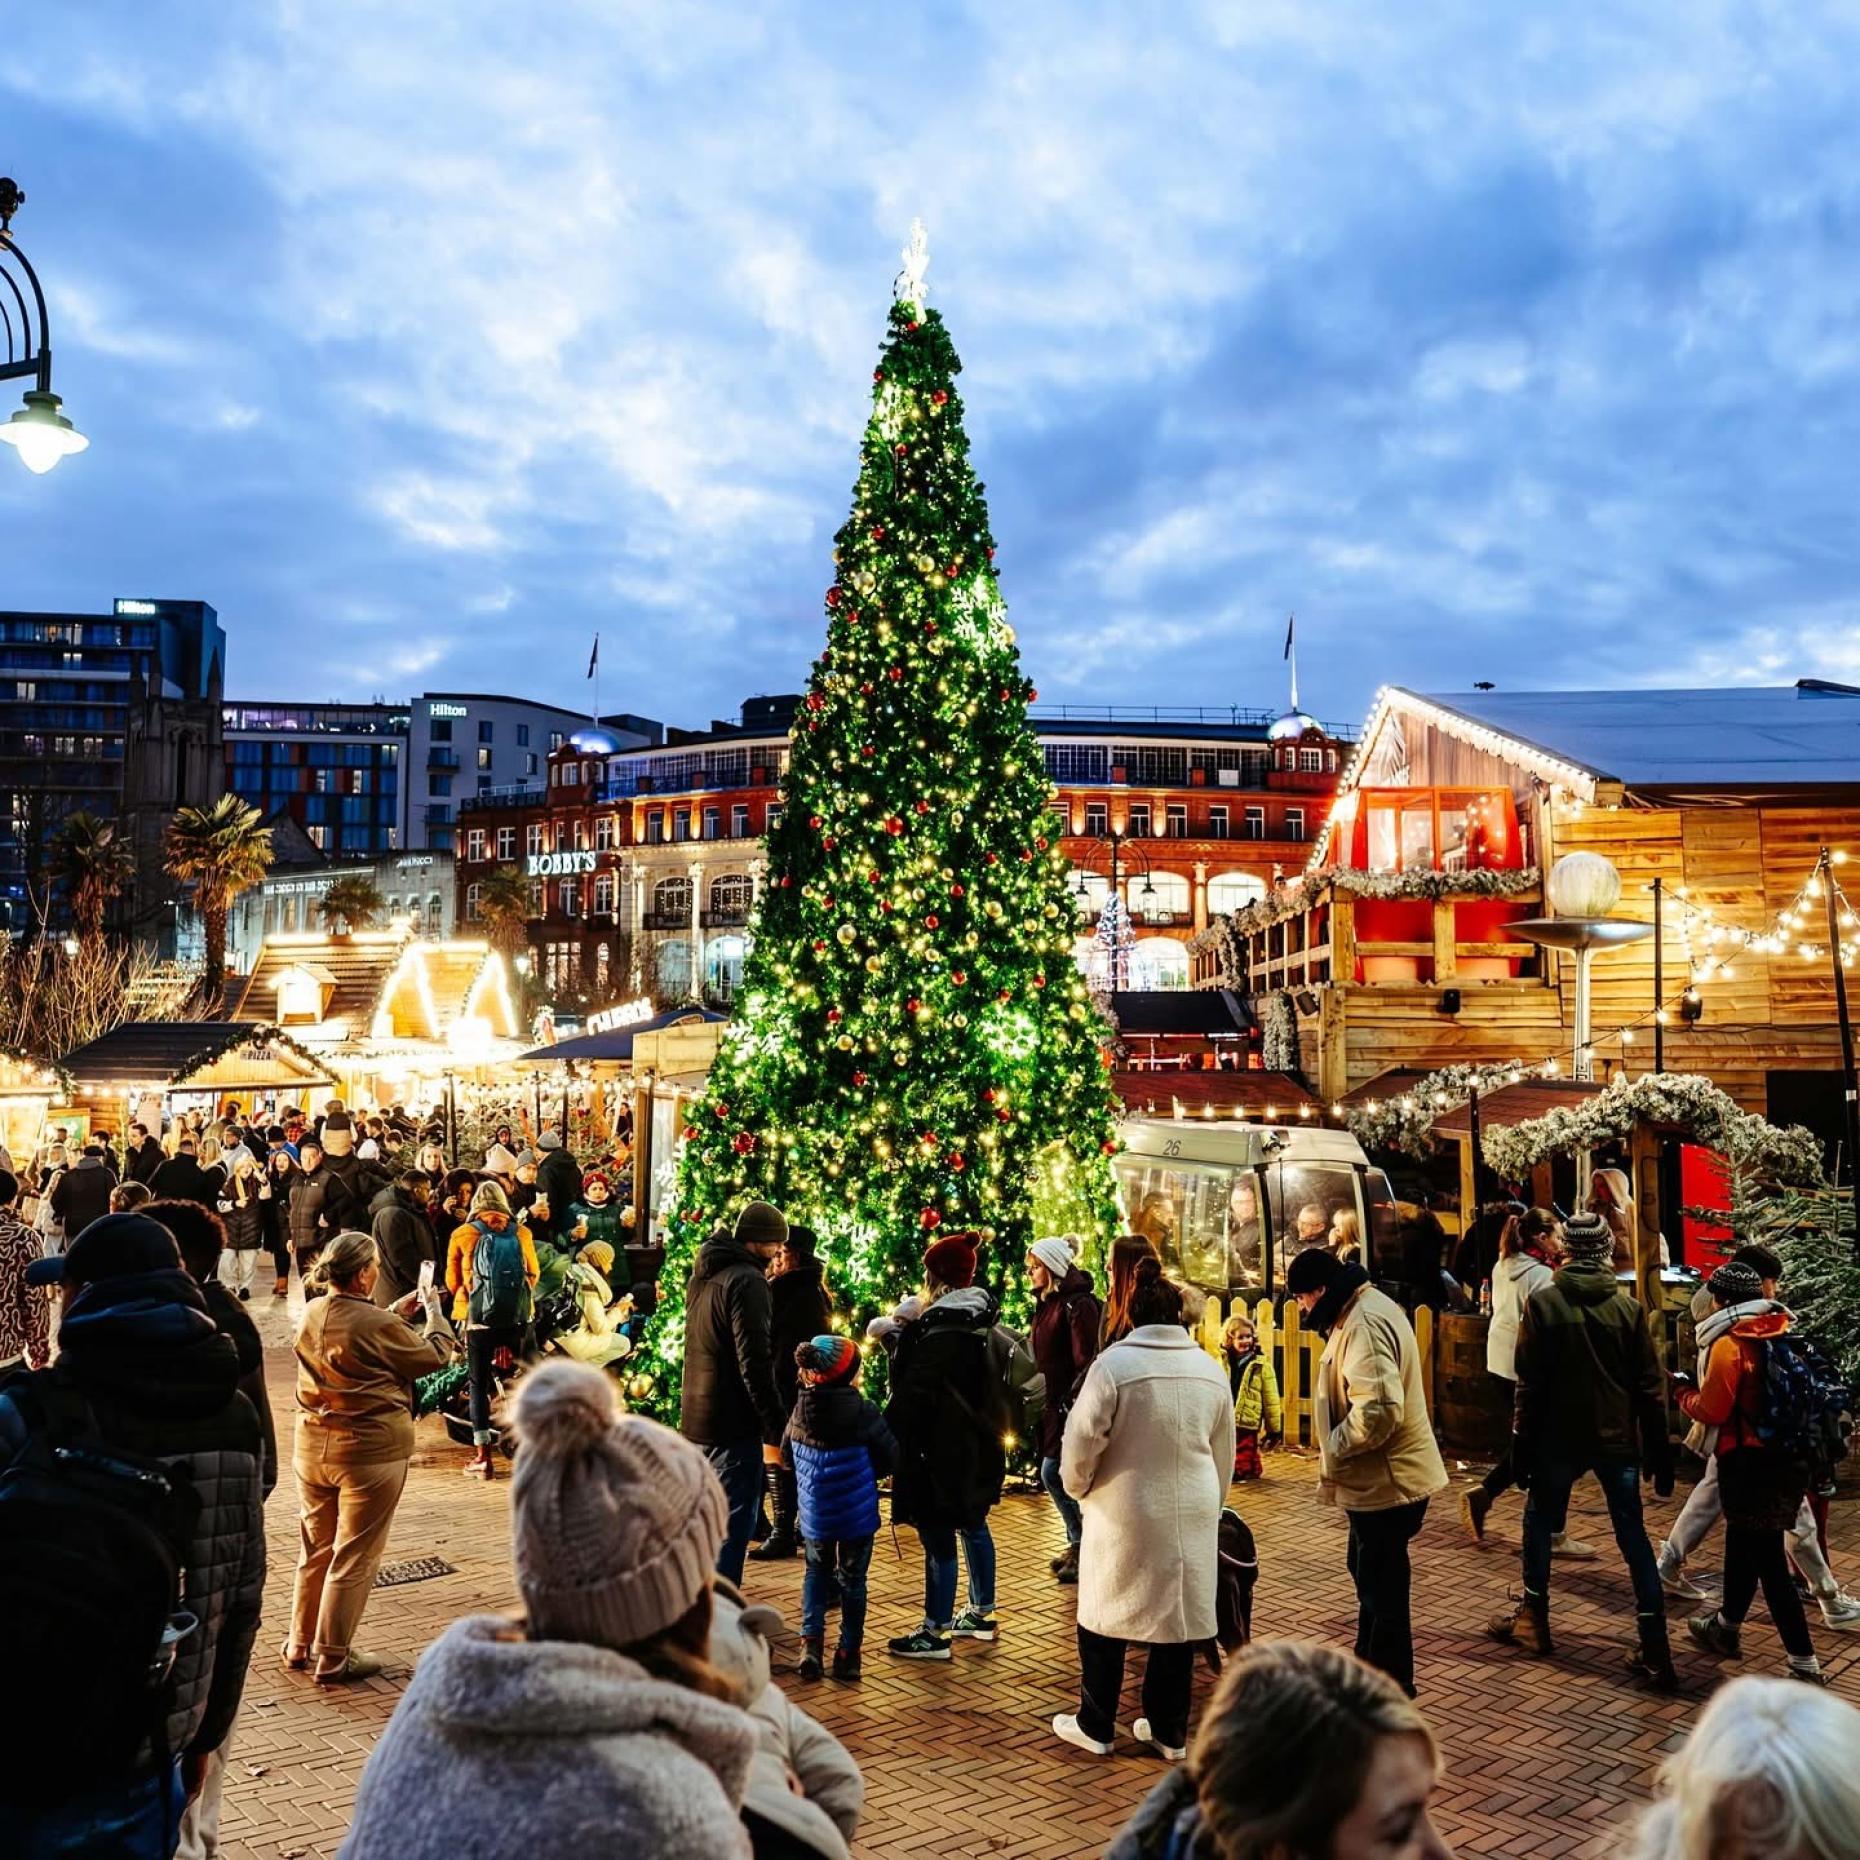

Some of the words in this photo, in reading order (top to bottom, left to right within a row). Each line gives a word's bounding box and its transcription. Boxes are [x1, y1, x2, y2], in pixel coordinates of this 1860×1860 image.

[430, 703, 467, 717] Hilton
[527, 850, 597, 877] BOBBY'S
[1162, 1139, 1182, 1156] 26
